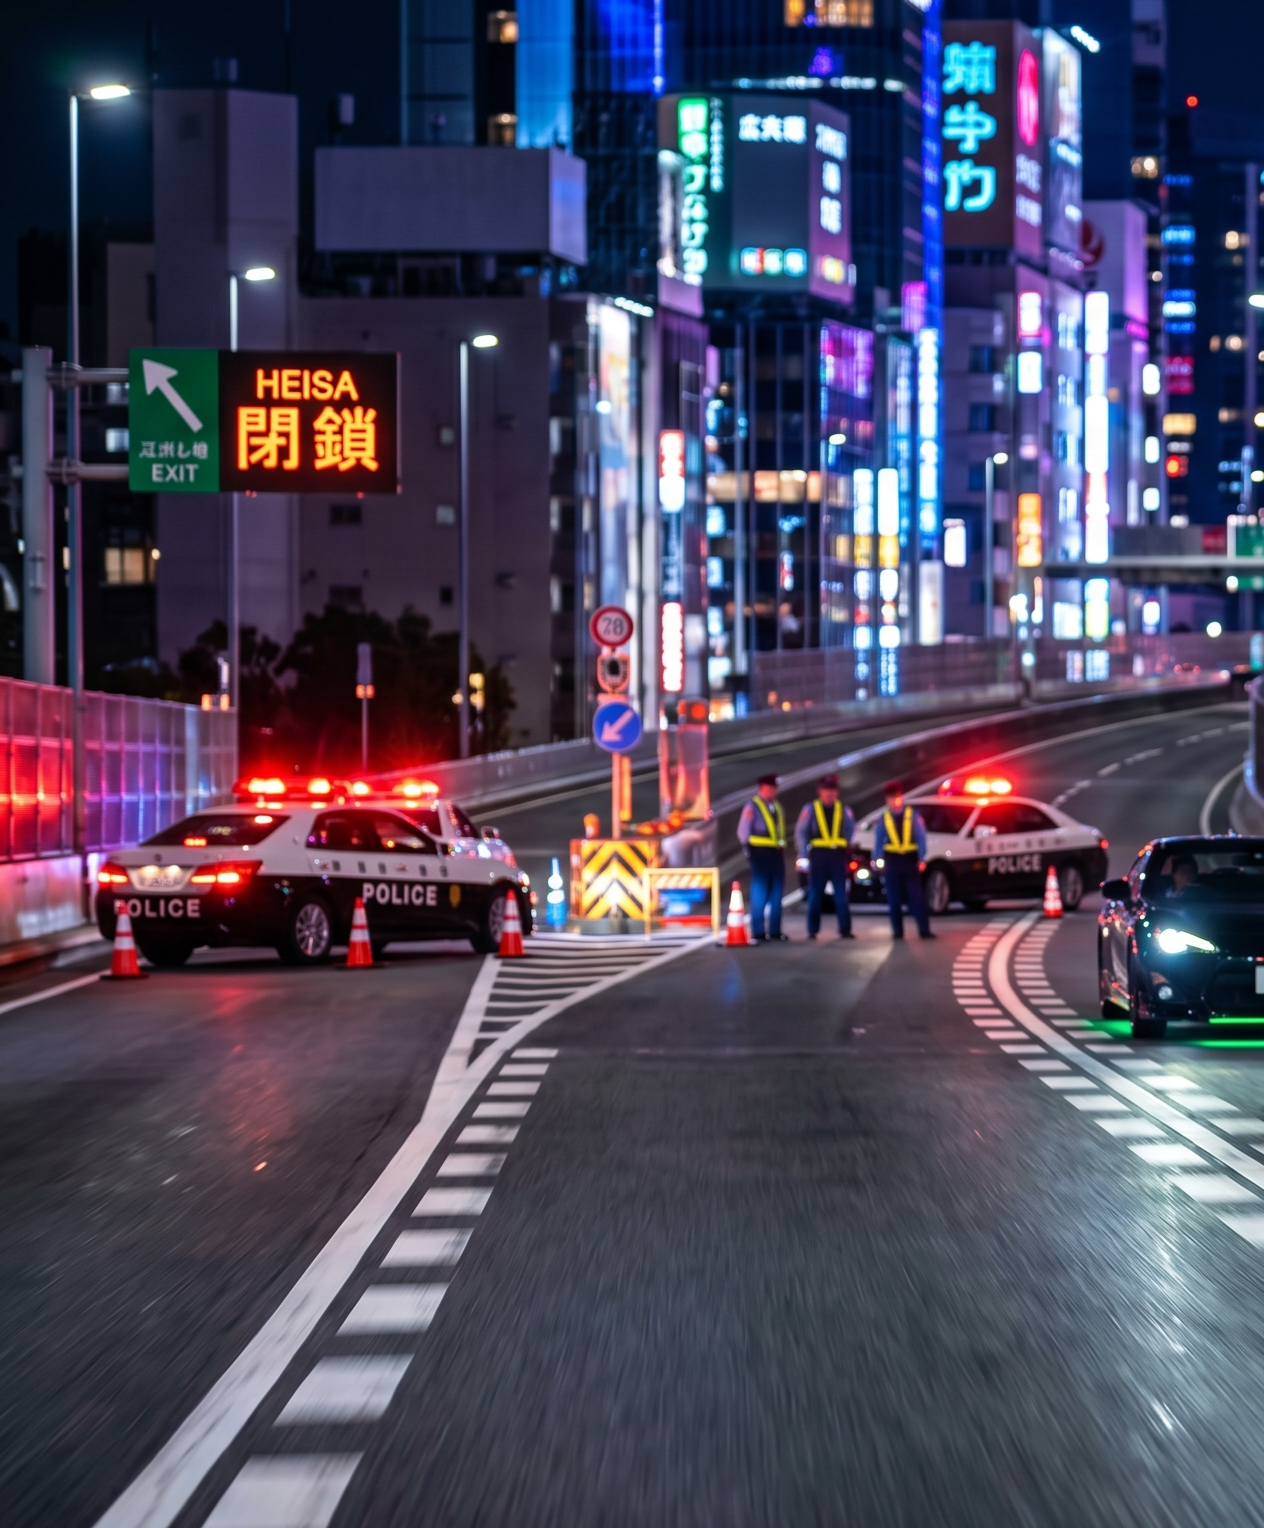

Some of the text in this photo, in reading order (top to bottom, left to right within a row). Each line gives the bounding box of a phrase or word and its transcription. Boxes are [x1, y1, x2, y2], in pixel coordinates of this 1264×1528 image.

[256, 368, 359, 401] HEISA
[236, 405, 381, 473] 閉鎖
[151, 463, 199, 483] EXIT
[988, 854, 1042, 875] POLICE
[362, 882, 438, 906] POLICE
